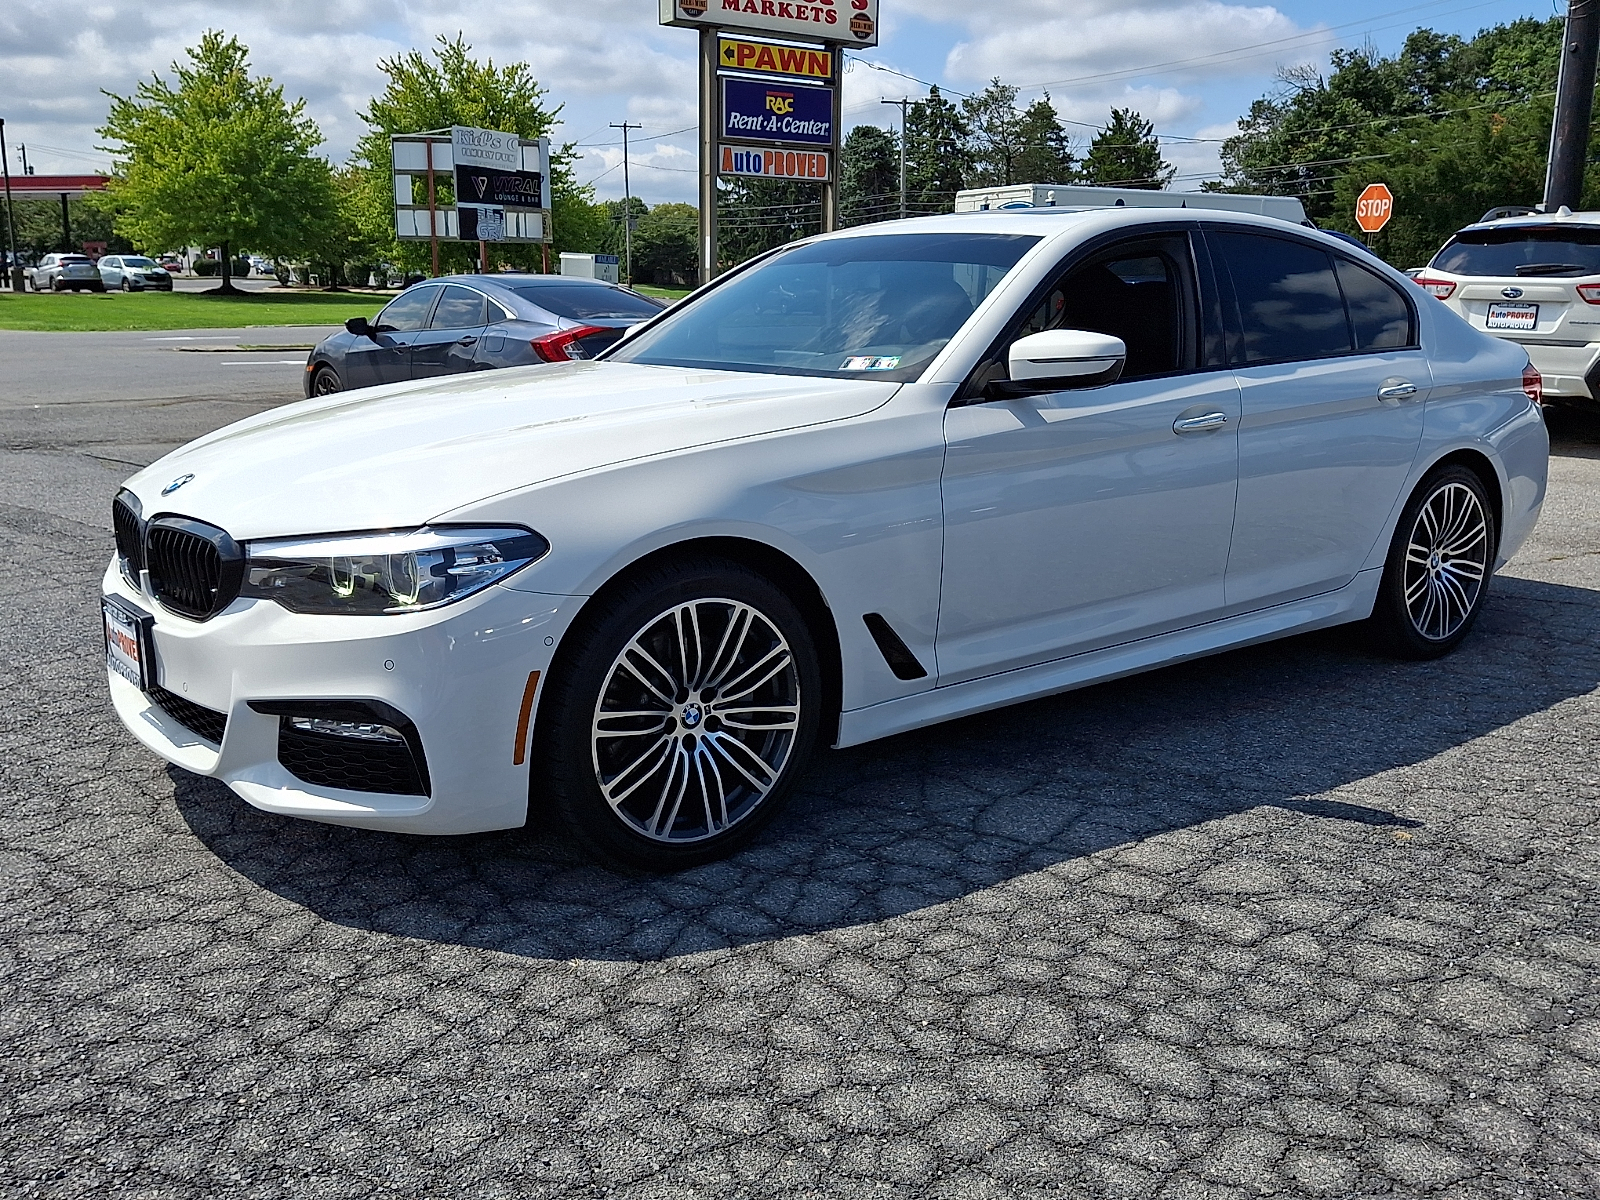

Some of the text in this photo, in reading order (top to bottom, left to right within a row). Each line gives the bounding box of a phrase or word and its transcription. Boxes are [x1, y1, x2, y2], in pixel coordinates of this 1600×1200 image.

[721, 0, 838, 25] MARKETS
[736, 43, 829, 76] PAWN
[765, 96, 794, 115] RAC
[456, 129, 502, 149] Kid's
[461, 147, 516, 164] FAMILY FUN
[722, 147, 827, 178] AutoPROVED
[492, 176, 541, 195] VYRAL
[494, 193, 519, 202] LOUNGE
[1358, 198, 1390, 217] STOP
[1490, 311, 1535, 320] AutoPROVED
